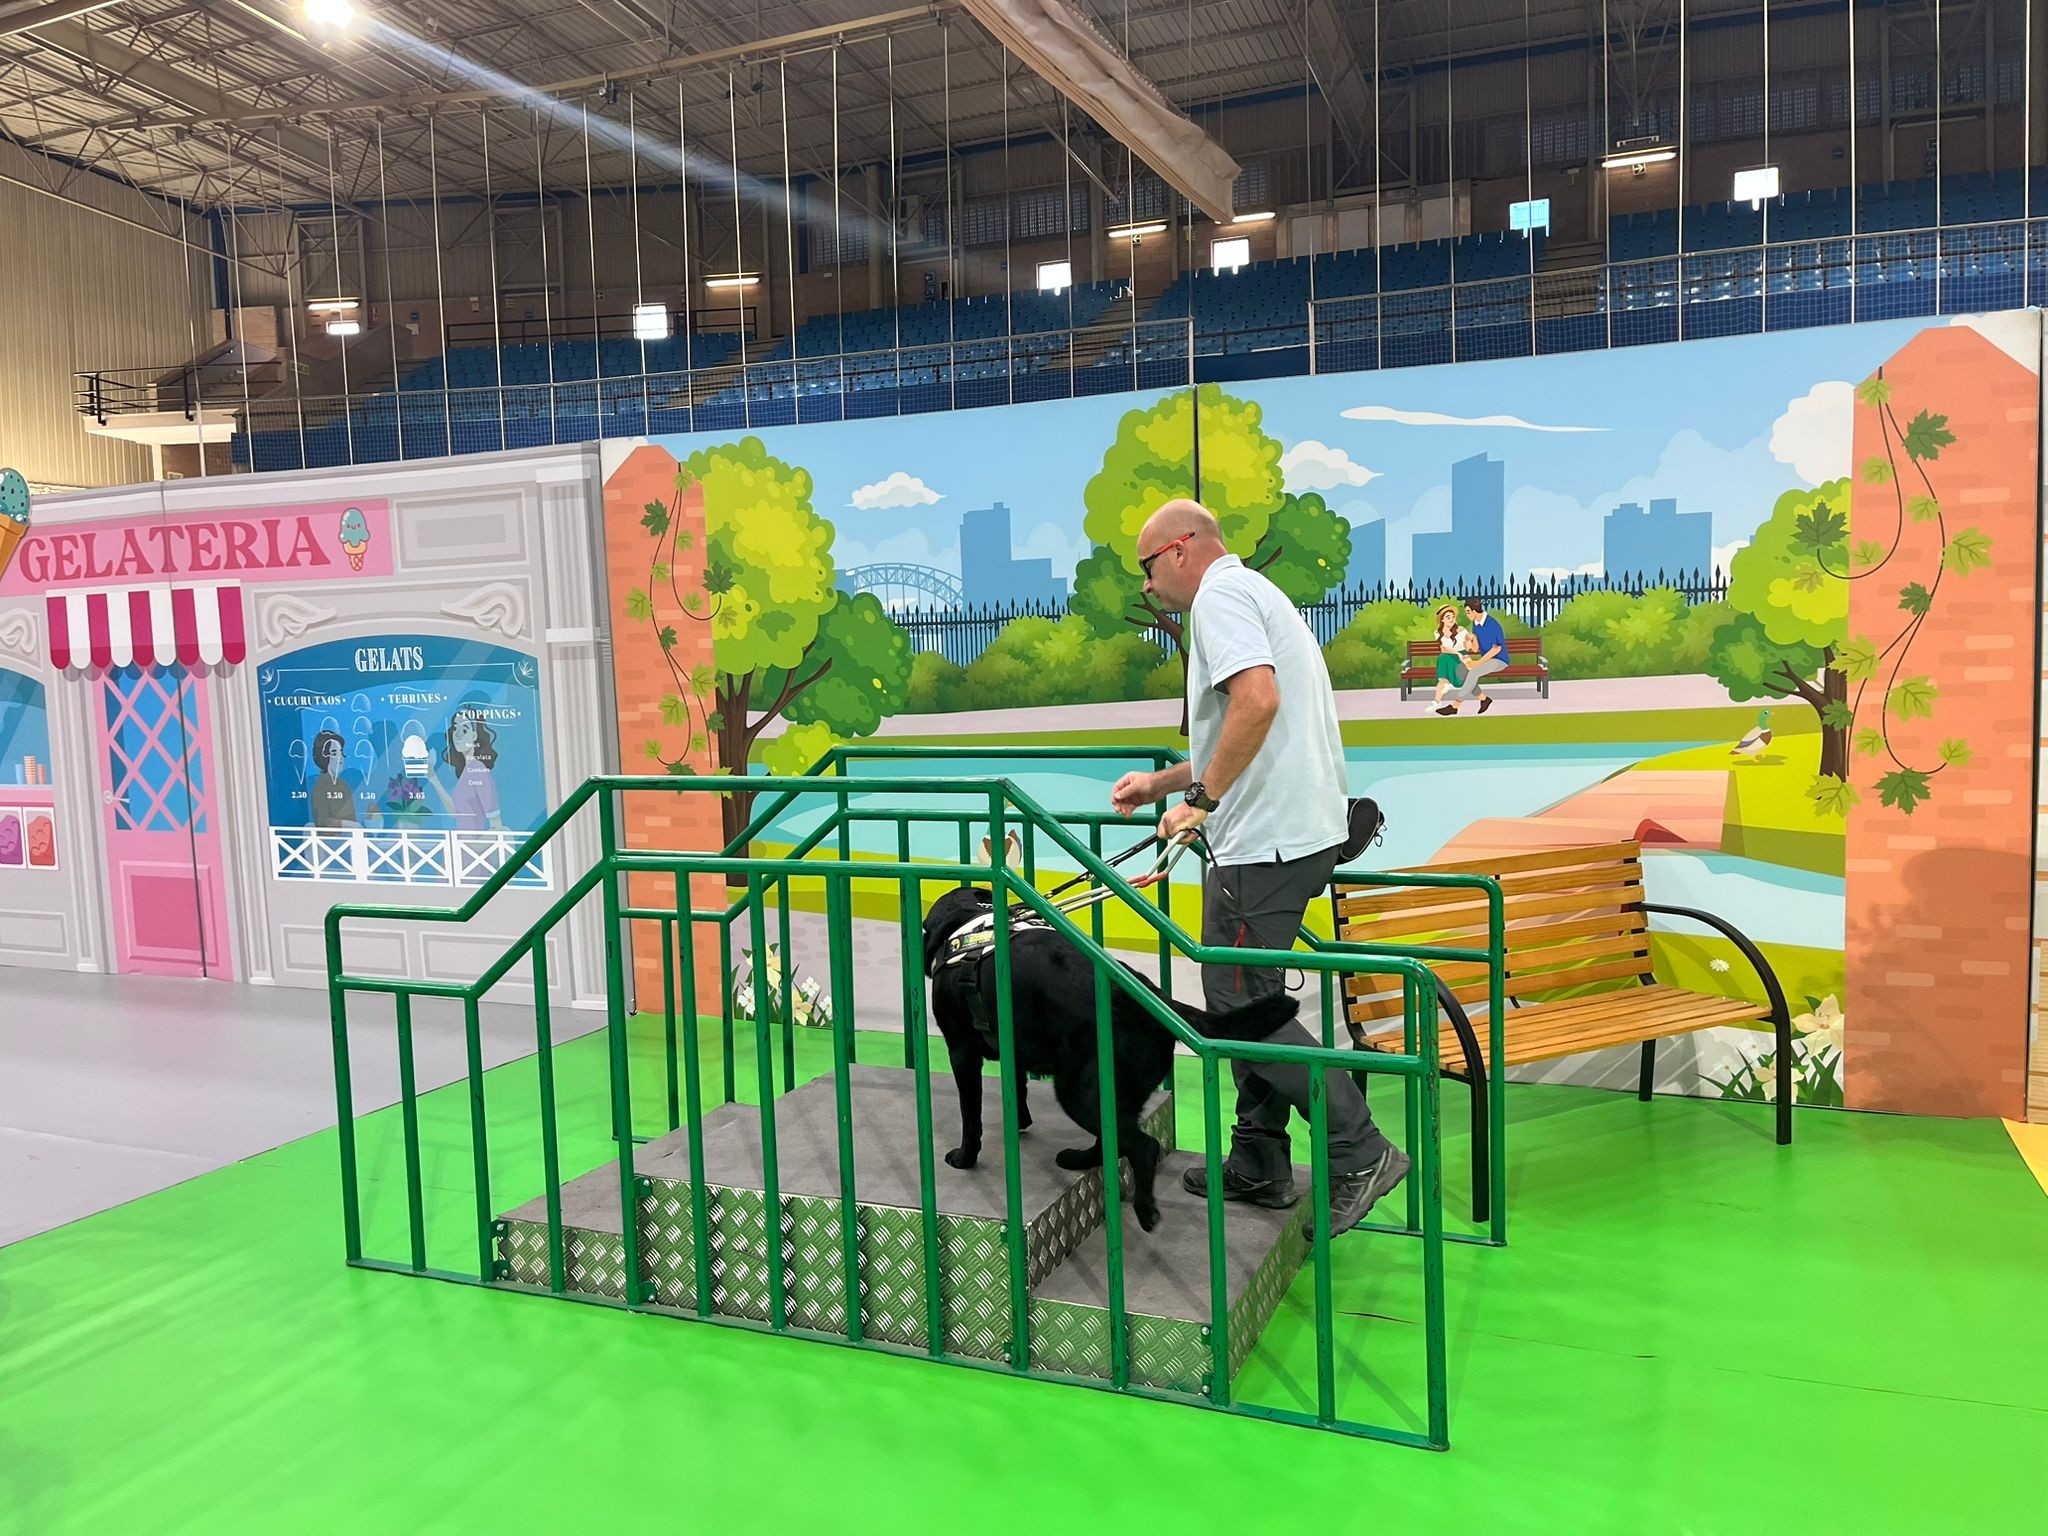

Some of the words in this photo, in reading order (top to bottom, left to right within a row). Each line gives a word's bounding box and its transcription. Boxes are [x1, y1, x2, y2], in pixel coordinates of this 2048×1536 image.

[19, 516, 332, 583] GELATERIA
[354, 646, 424, 672] GELATS
[274, 695, 341, 706] CUCURUTXOS
[388, 693, 441, 704] TERRINES
[460, 708, 516, 720] TOPPINGS
